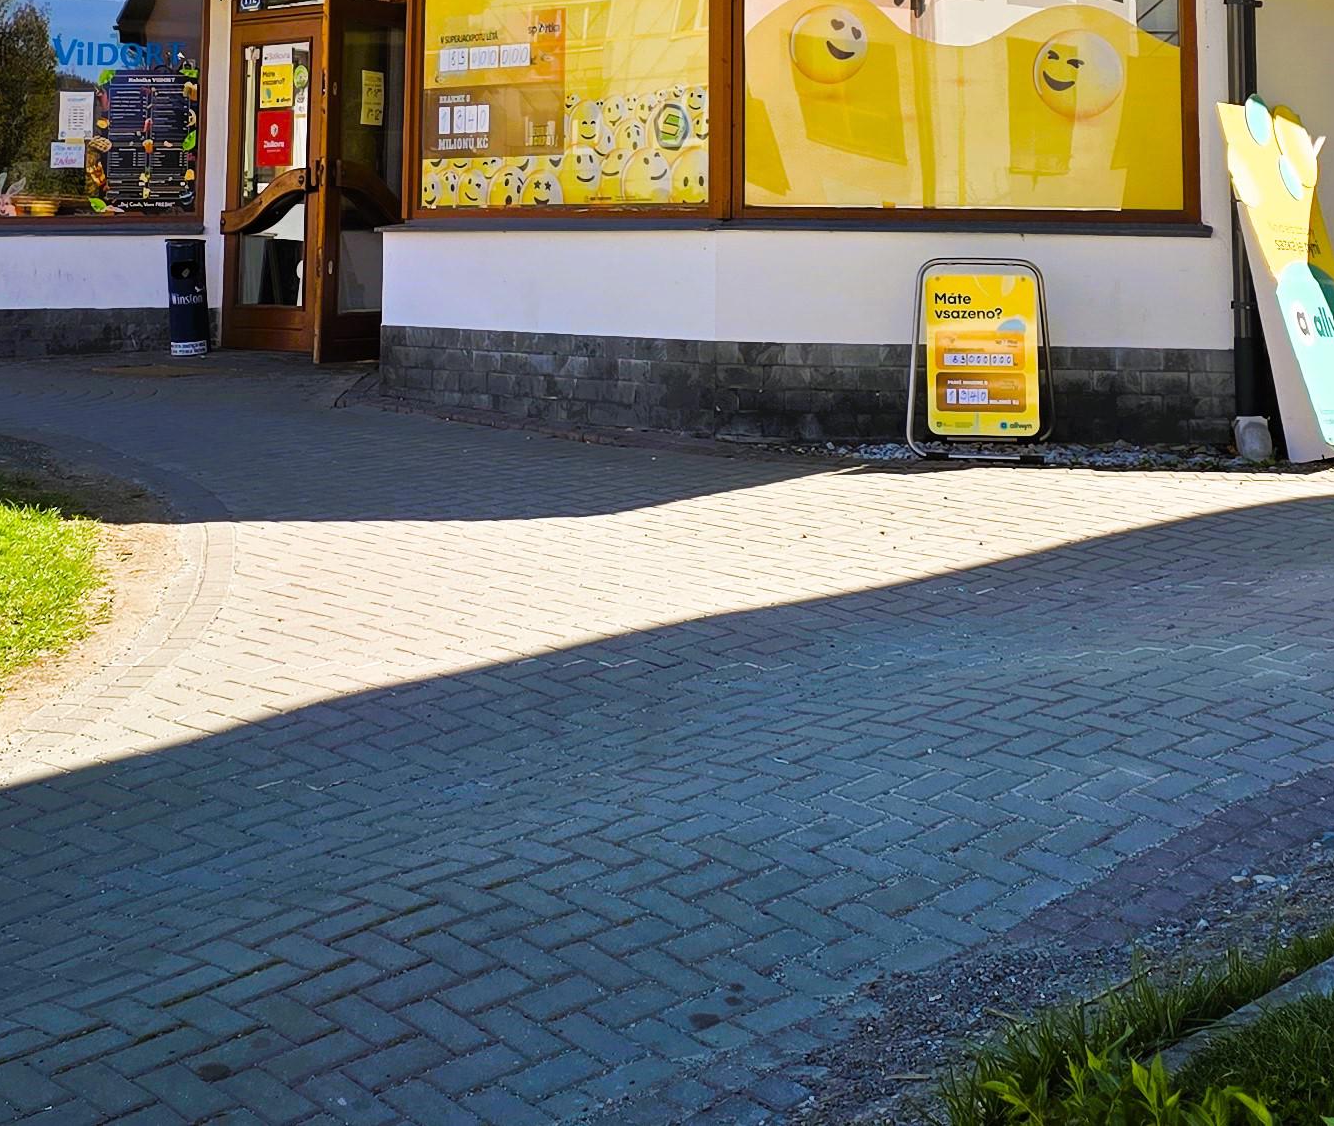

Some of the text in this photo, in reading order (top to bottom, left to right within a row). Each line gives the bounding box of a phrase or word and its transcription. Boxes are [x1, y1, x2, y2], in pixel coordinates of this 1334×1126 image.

[438, 135, 475, 150] MILIONŮ
[171, 293, 203, 305] Winston
[935, 292, 971, 305] Máte
[935, 308, 1002, 320] vsazeno?
